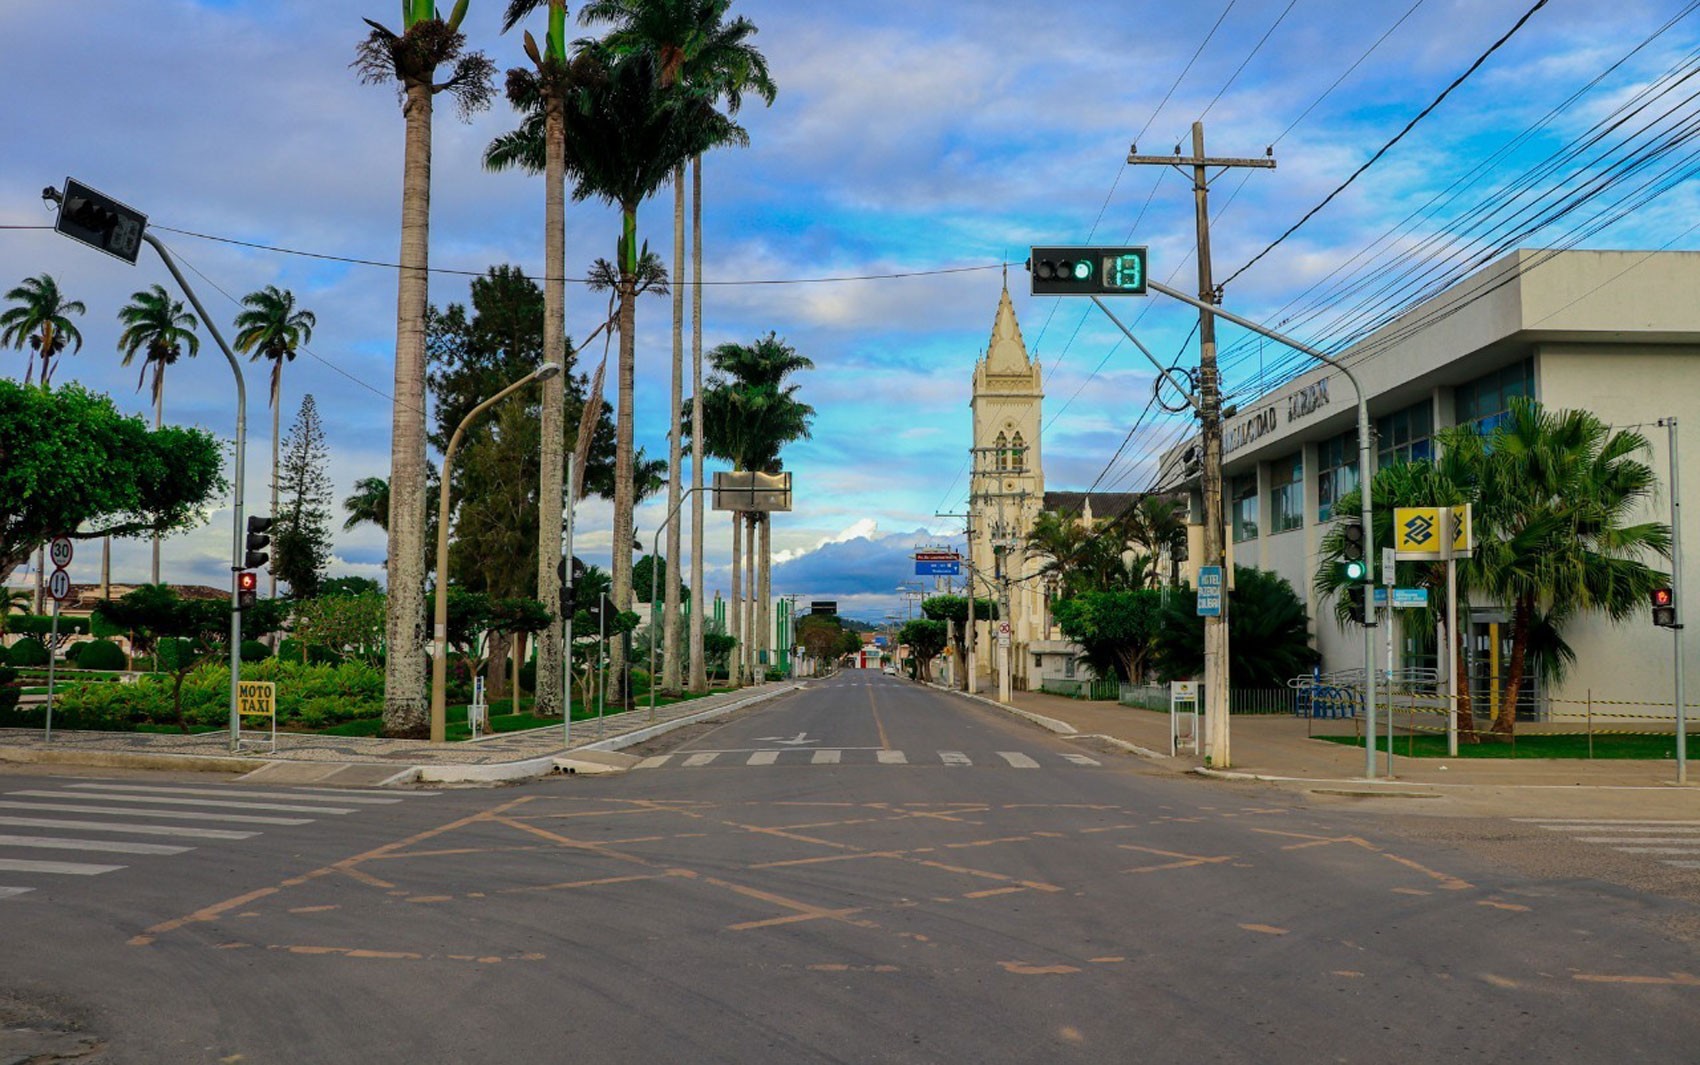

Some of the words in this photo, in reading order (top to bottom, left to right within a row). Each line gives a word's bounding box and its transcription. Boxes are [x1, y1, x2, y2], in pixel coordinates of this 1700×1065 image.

[1116, 254, 1140, 288] 13
[54, 543, 69, 558] 30
[239, 685, 271, 698] MOTO
[241, 699, 269, 712] TAXI
